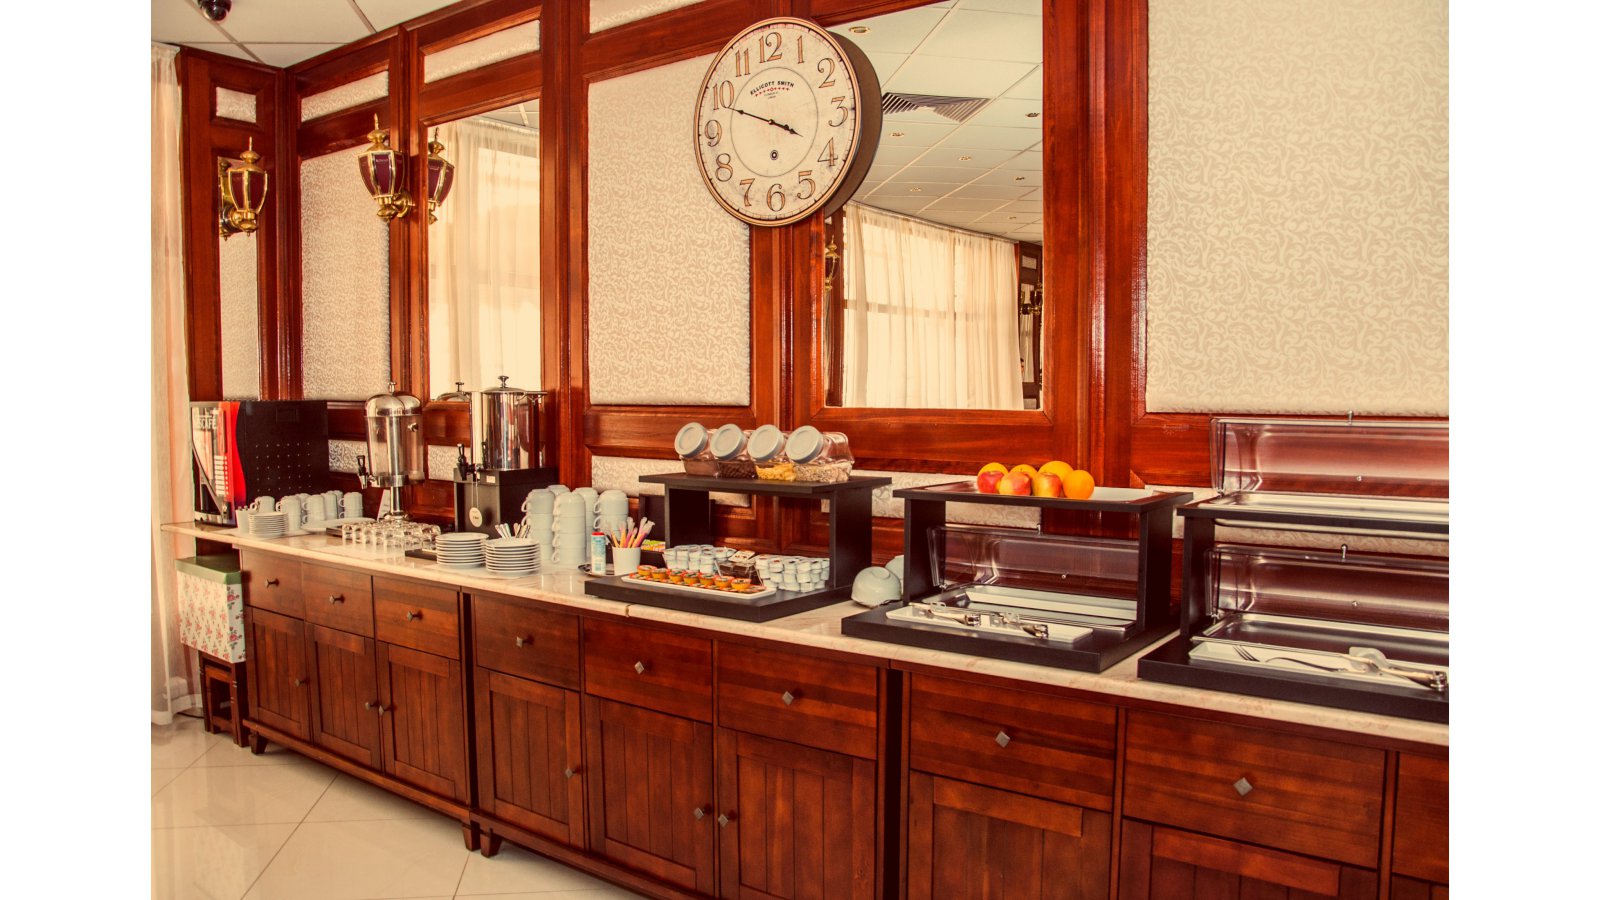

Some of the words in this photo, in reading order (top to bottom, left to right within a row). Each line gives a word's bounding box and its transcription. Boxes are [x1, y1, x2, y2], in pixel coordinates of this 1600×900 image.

[734, 47, 751, 77] 11
[758, 31, 783, 64] 12
[797, 35, 805, 64] 1
[750, 80, 775, 95] ELLICOTT
[777, 80, 794, 88] SMITH
[817, 57, 836, 88] 2
[712, 79, 735, 111] 10
[828, 95, 848, 127] 3
[704, 119, 723, 147] 9
[715, 152, 733, 182] 8
[817, 137, 838, 167] 4
[739, 177, 755, 207] 7
[766, 183, 786, 212] 6
[796, 169, 816, 200] 5
